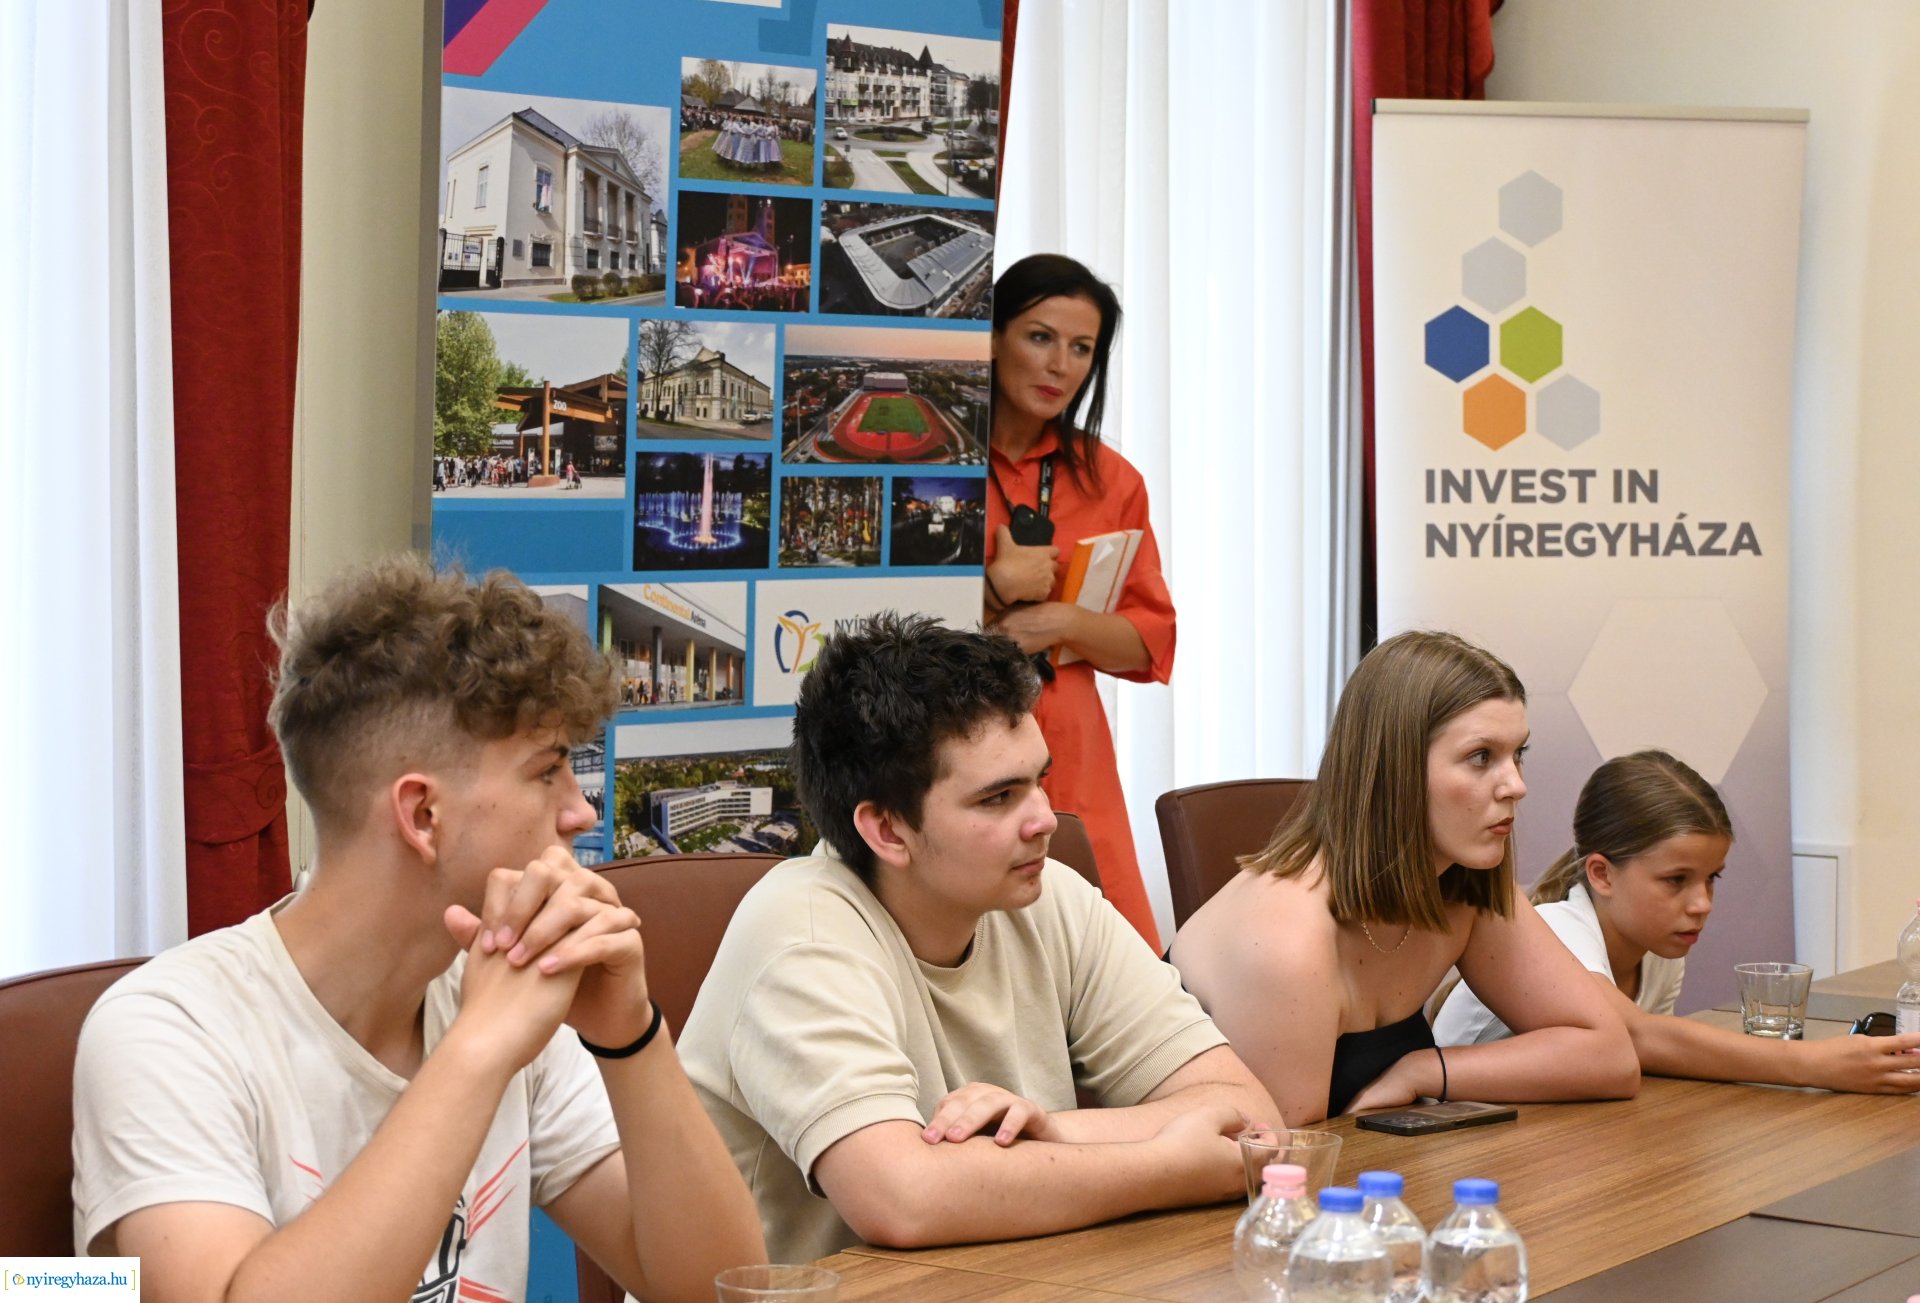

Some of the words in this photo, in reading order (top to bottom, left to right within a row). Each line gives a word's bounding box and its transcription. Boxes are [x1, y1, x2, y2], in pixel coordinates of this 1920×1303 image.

[1425, 468, 1597, 504] INVEST
[1613, 468, 1659, 504] IN
[1425, 512, 1763, 558] NYÍREGYHÁZA
